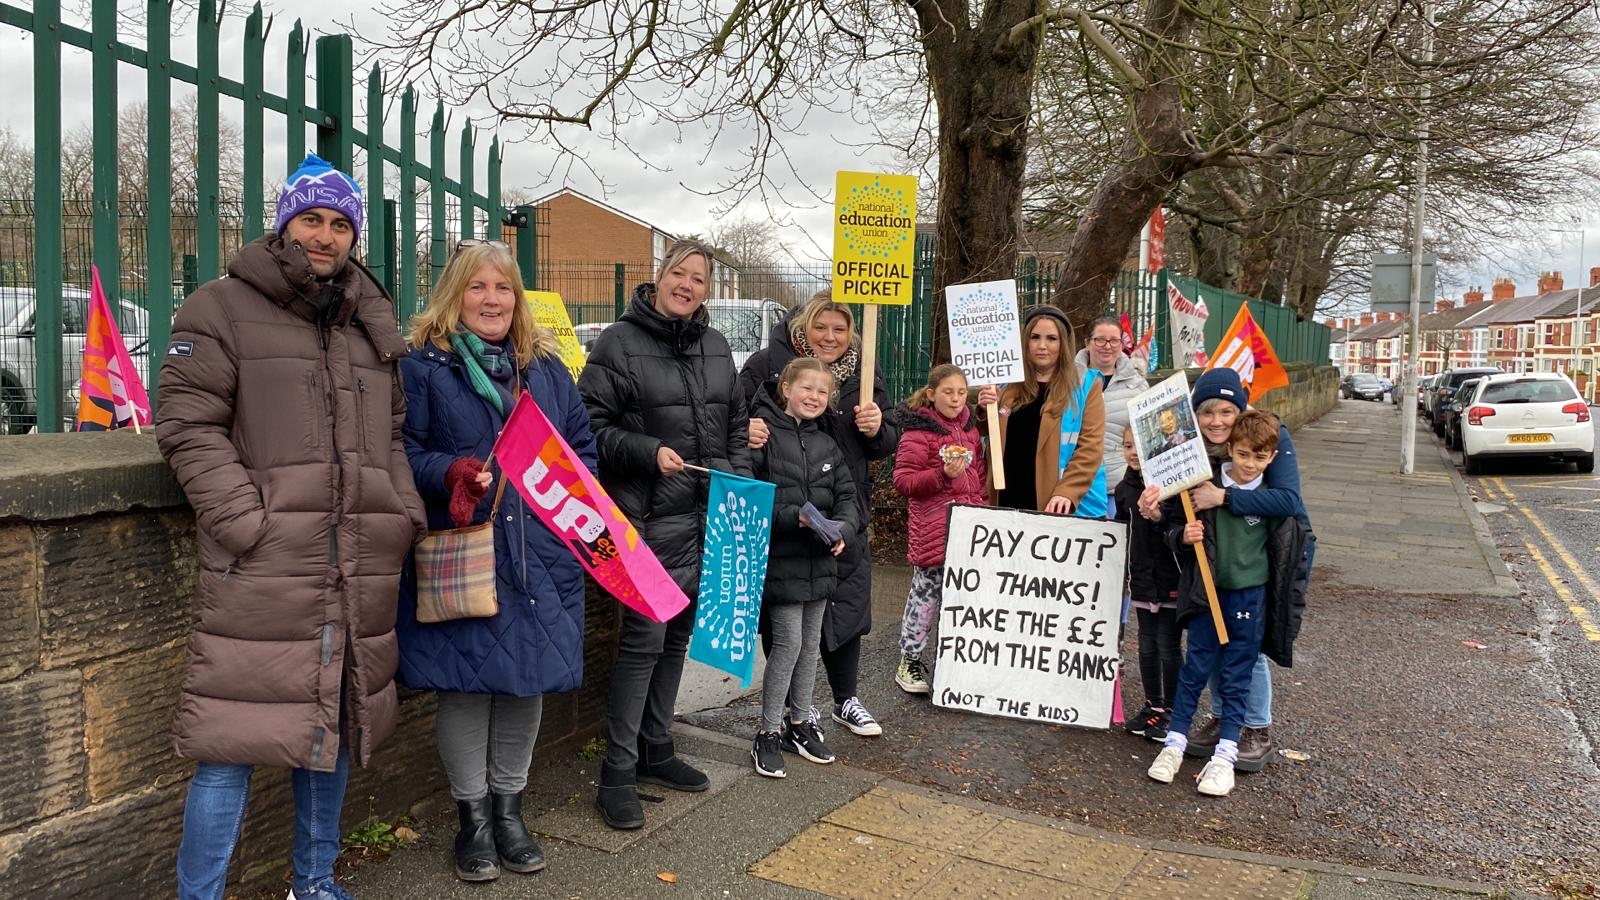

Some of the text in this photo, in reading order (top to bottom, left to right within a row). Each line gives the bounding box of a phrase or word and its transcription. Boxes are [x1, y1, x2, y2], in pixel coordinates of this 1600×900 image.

[858, 202, 894, 213] national
[839, 212, 912, 229] education
[862, 228, 888, 238] union
[837, 261, 909, 279] OFFICIAL
[844, 280, 901, 296] PICKET
[966, 303, 998, 314] national
[951, 311, 1015, 328] education
[972, 324, 995, 334] union
[954, 349, 1019, 367] OFFICIAL
[964, 364, 1013, 379] PICKET
[1137, 401, 1148, 410] I'd
[1149, 391, 1165, 403] love
[1172, 444, 1193, 457] funded
[1151, 465, 1173, 478] schools
[1162, 467, 1195, 488] LOVE IT!
[970, 524, 1117, 568] PAY CUT?
[720, 543, 735, 604] union
[727, 491, 750, 662] education
[749, 533, 758, 619] national
[945, 566, 1100, 610] NO THANKS!
[944, 605, 1107, 647] TAKE THE ££
[939, 636, 1118, 682] FROM THE BANKS
[941, 687, 1079, 723] (NOT THE KIDS)
